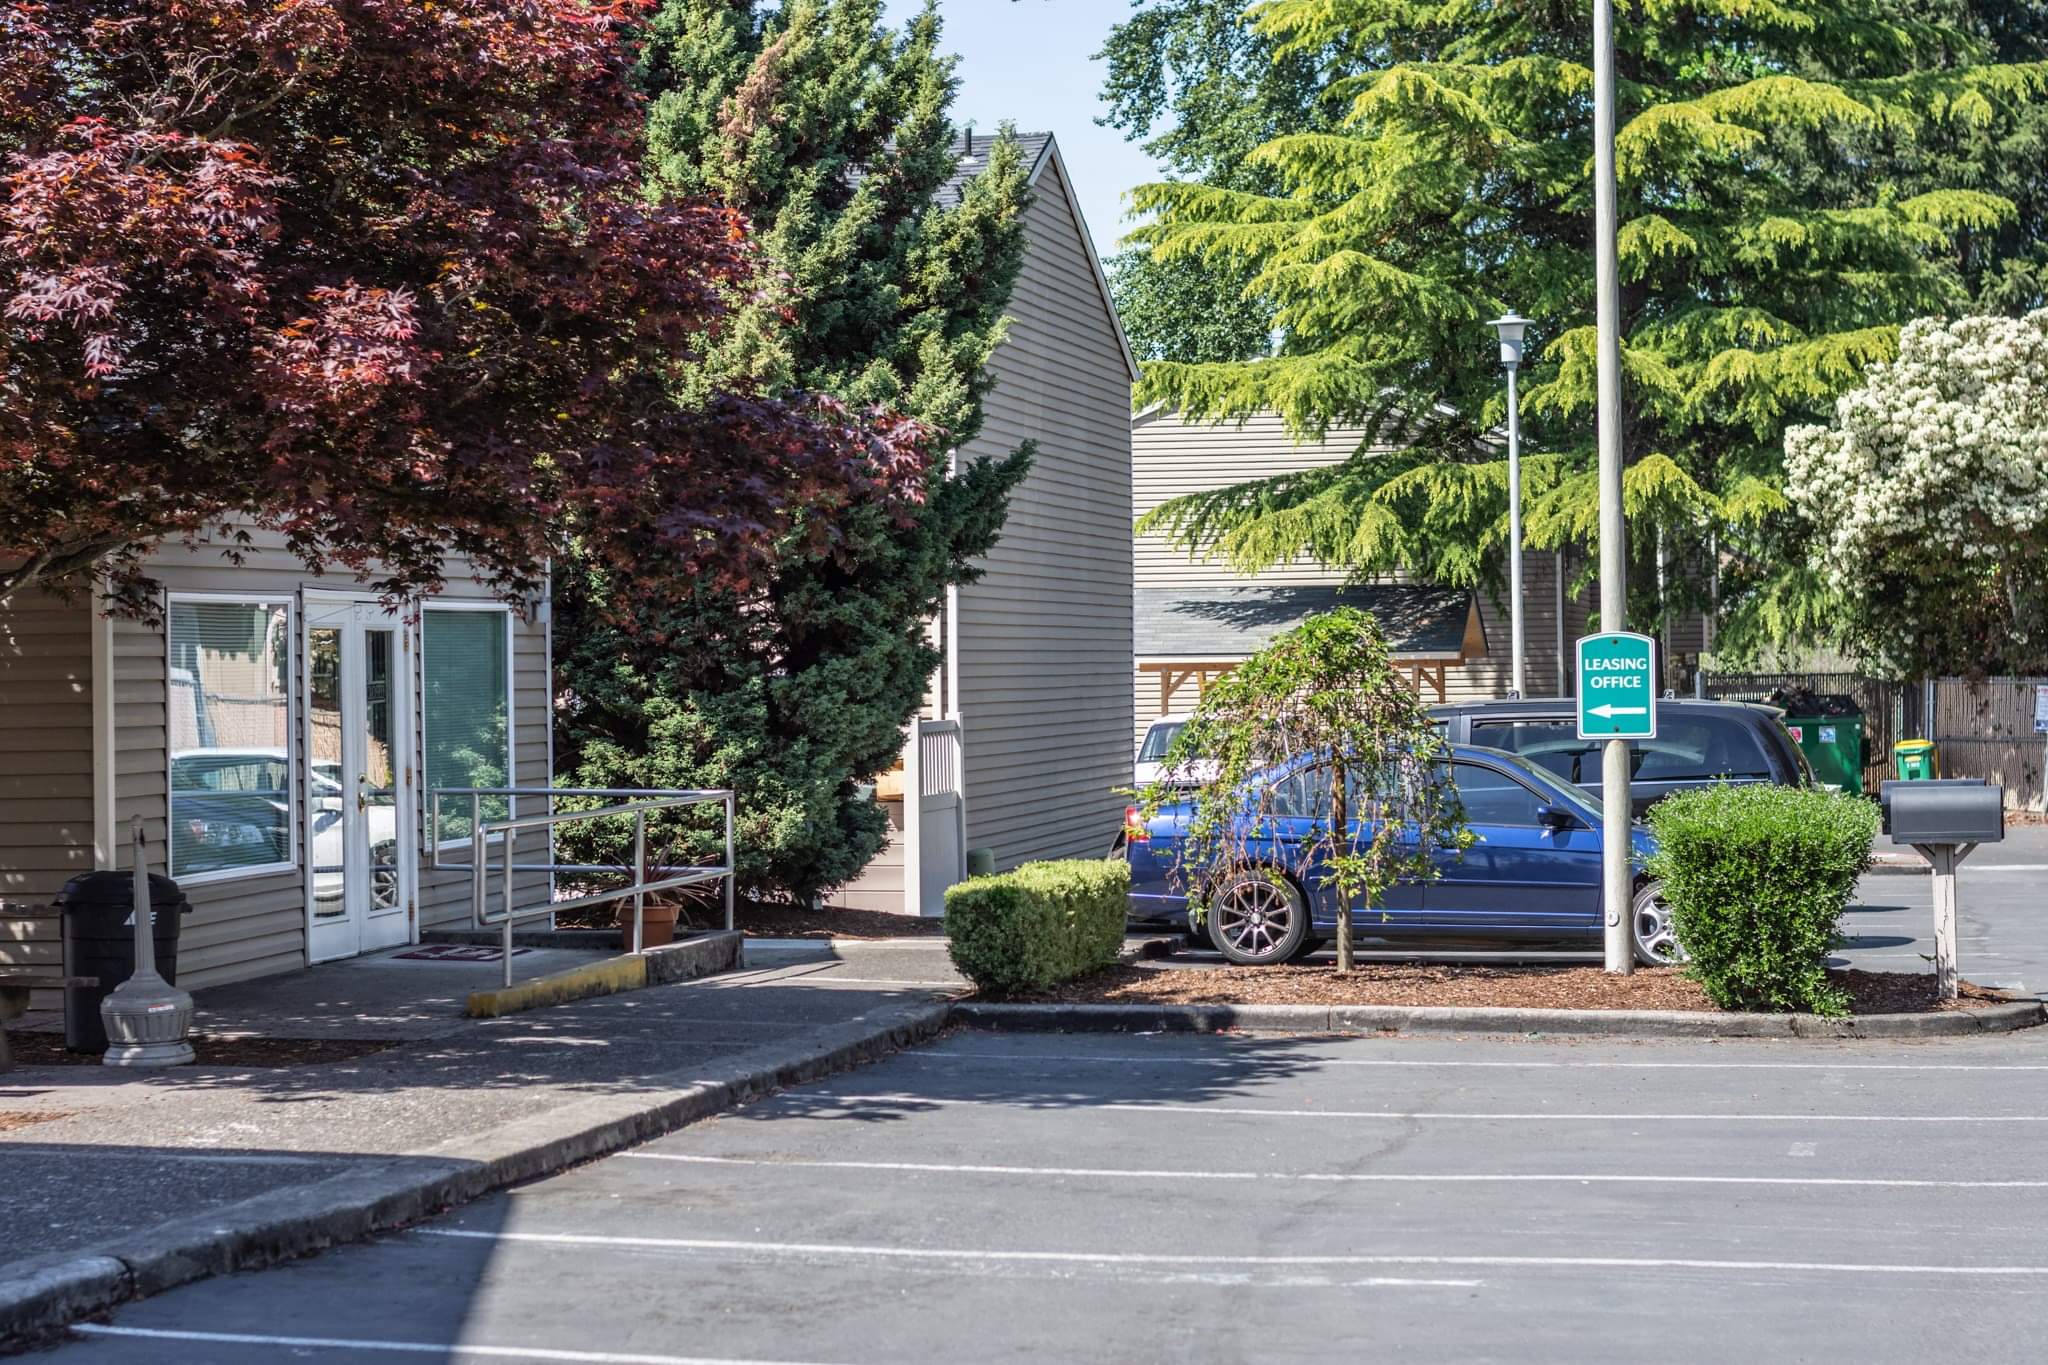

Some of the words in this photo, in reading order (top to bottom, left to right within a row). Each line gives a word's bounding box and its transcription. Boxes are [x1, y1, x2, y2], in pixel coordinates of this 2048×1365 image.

[1584, 658, 1647, 670] LEASING
[1590, 676, 1642, 688] OFFICE
[123, 910, 158, 925] AE
